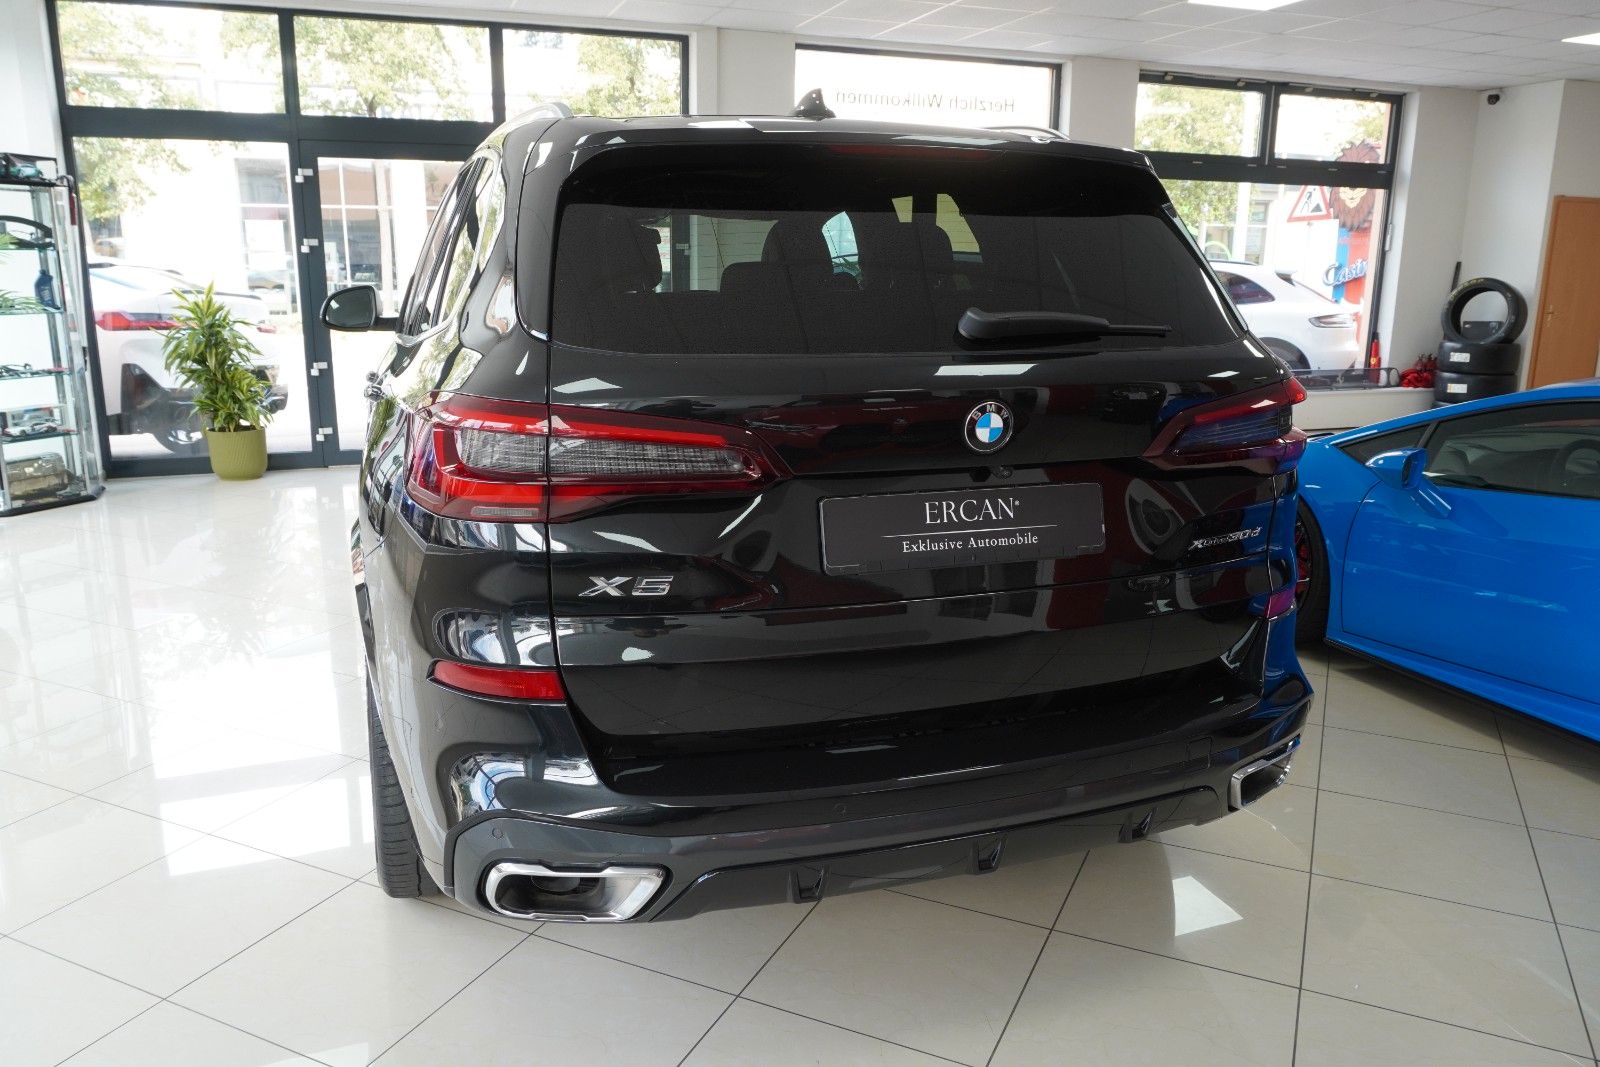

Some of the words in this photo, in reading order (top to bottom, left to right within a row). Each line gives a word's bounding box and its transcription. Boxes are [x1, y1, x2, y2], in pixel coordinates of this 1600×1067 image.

[971, 403, 1009, 420] BMW
[902, 539, 963, 553] Exklusive
[968, 532, 1039, 548] Automobile
[578, 575, 674, 597] X5
